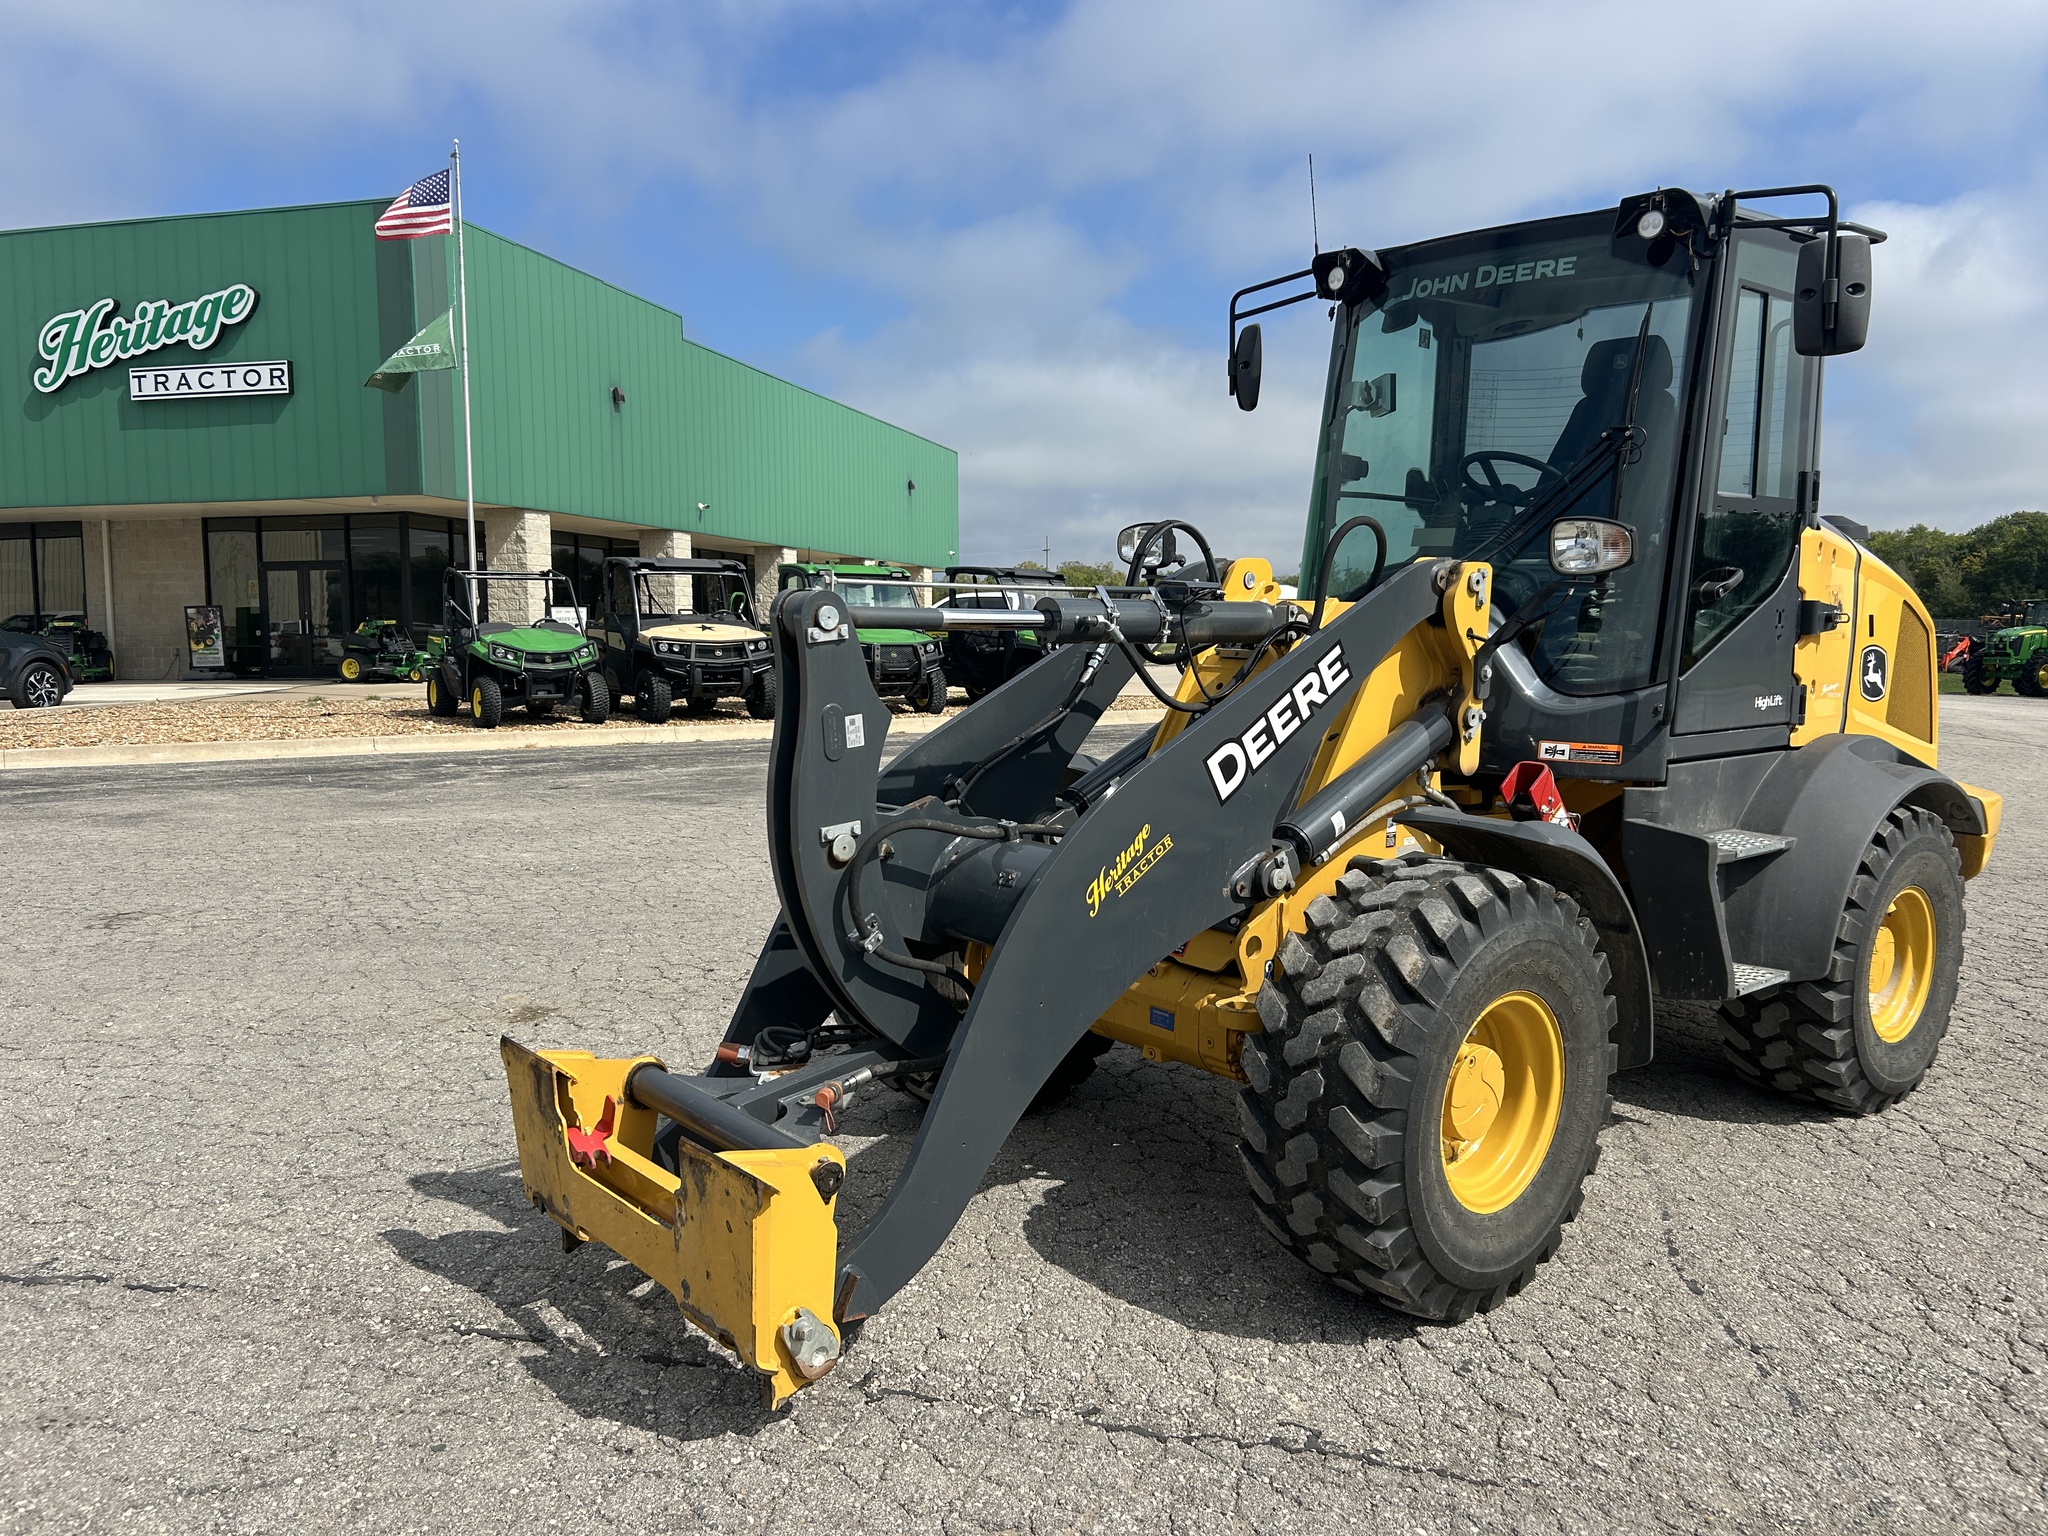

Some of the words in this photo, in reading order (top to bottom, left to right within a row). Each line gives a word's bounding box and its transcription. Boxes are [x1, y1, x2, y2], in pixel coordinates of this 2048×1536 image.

[1402, 272, 1469, 301] JOHN
[1474, 256, 1578, 289] DEERE
[34, 283, 255, 393] Heritage
[132, 367, 287, 393] TRACTOR
[1204, 643, 1351, 802] DEERE
[1086, 823, 1151, 918] Heritage
[1115, 836, 1173, 895] TRACTOR
